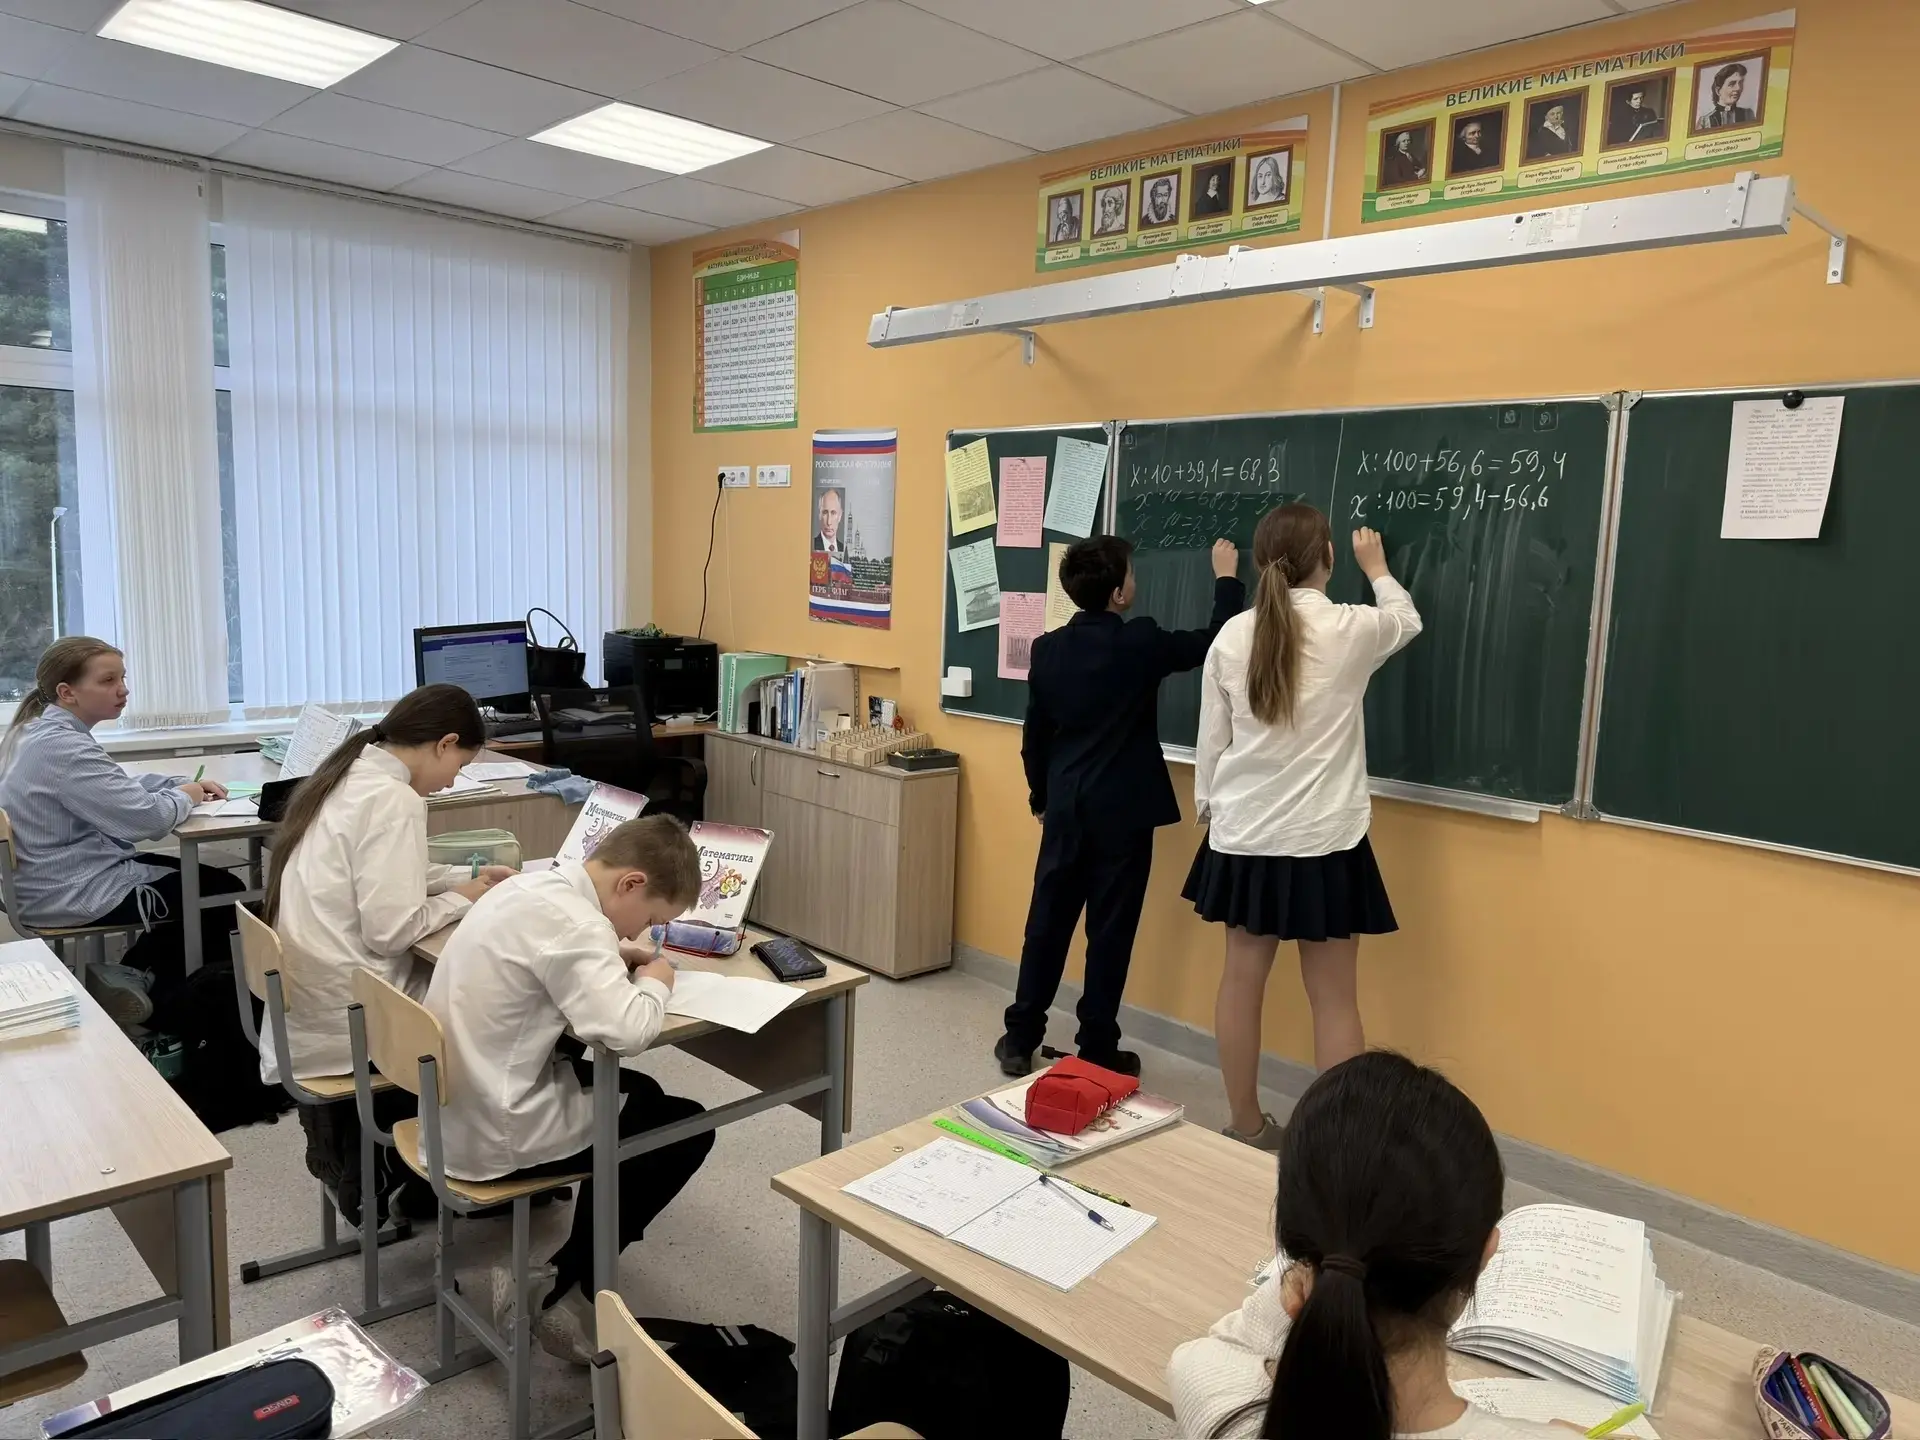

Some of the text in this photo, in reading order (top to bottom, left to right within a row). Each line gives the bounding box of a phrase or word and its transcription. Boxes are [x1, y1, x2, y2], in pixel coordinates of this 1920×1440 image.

[1445, 42, 1686, 108] ВЕЛИКИЕ МАТЕМАТИКИ
[1089, 137, 1242, 181] ВЕЛИКИЕ МАТЕМАТИКИ
[811, 584, 827, 595] ГЕРБ
[590, 817, 600, 829] 5
[703, 859, 713, 872] 5
